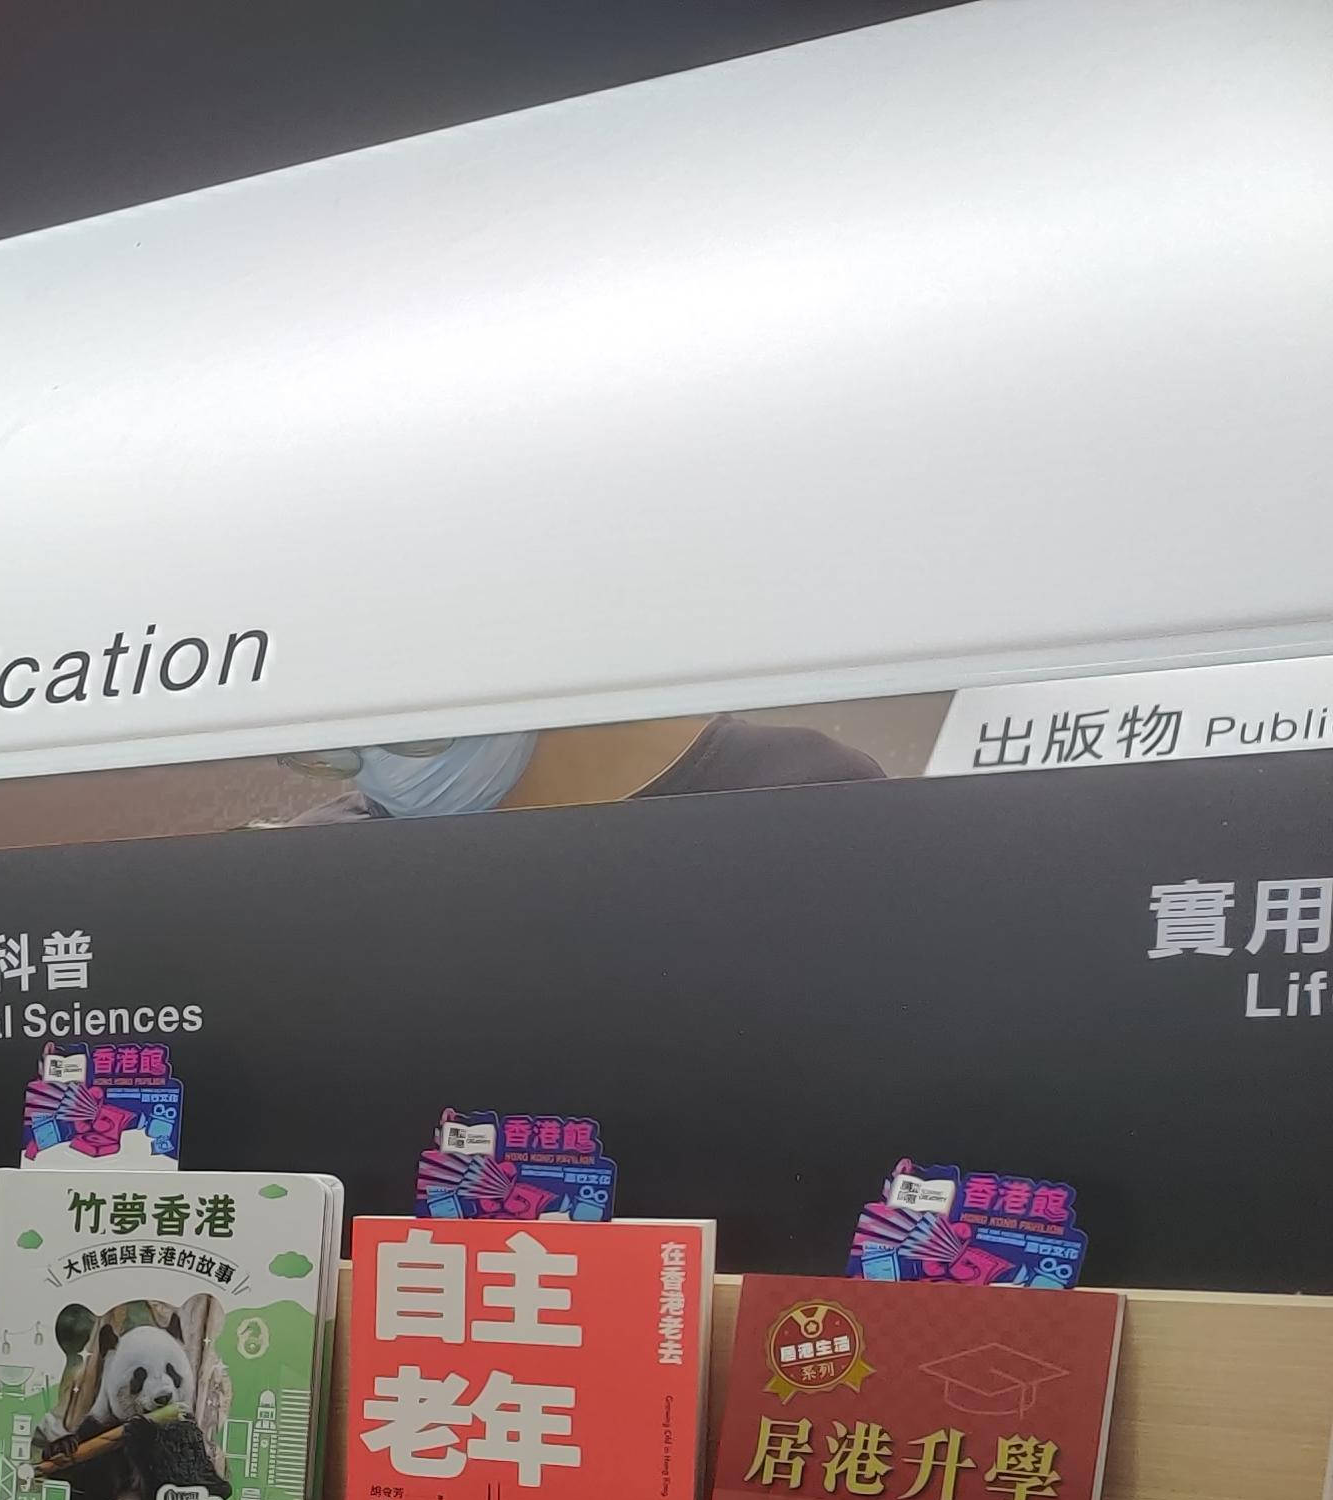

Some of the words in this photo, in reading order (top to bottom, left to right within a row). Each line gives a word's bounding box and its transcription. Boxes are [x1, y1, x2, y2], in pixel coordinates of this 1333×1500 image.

[972, 703, 1184, 768] 出版物
[1146, 878, 1333, 960] 實用
[1244, 970, 1333, 1019] Lif
[22, 997, 204, 1042] Sciences
[93, 1047, 167, 1076] 香港館
[504, 1118, 597, 1154] 香港館
[963, 1176, 1069, 1223] 香港館
[62, 1244, 237, 1285] 大熊貓與香港的故事
[374, 1228, 583, 1349] 自主
[800, 1360, 836, 1382] 系列
[359, 1364, 582, 1488] 老年
